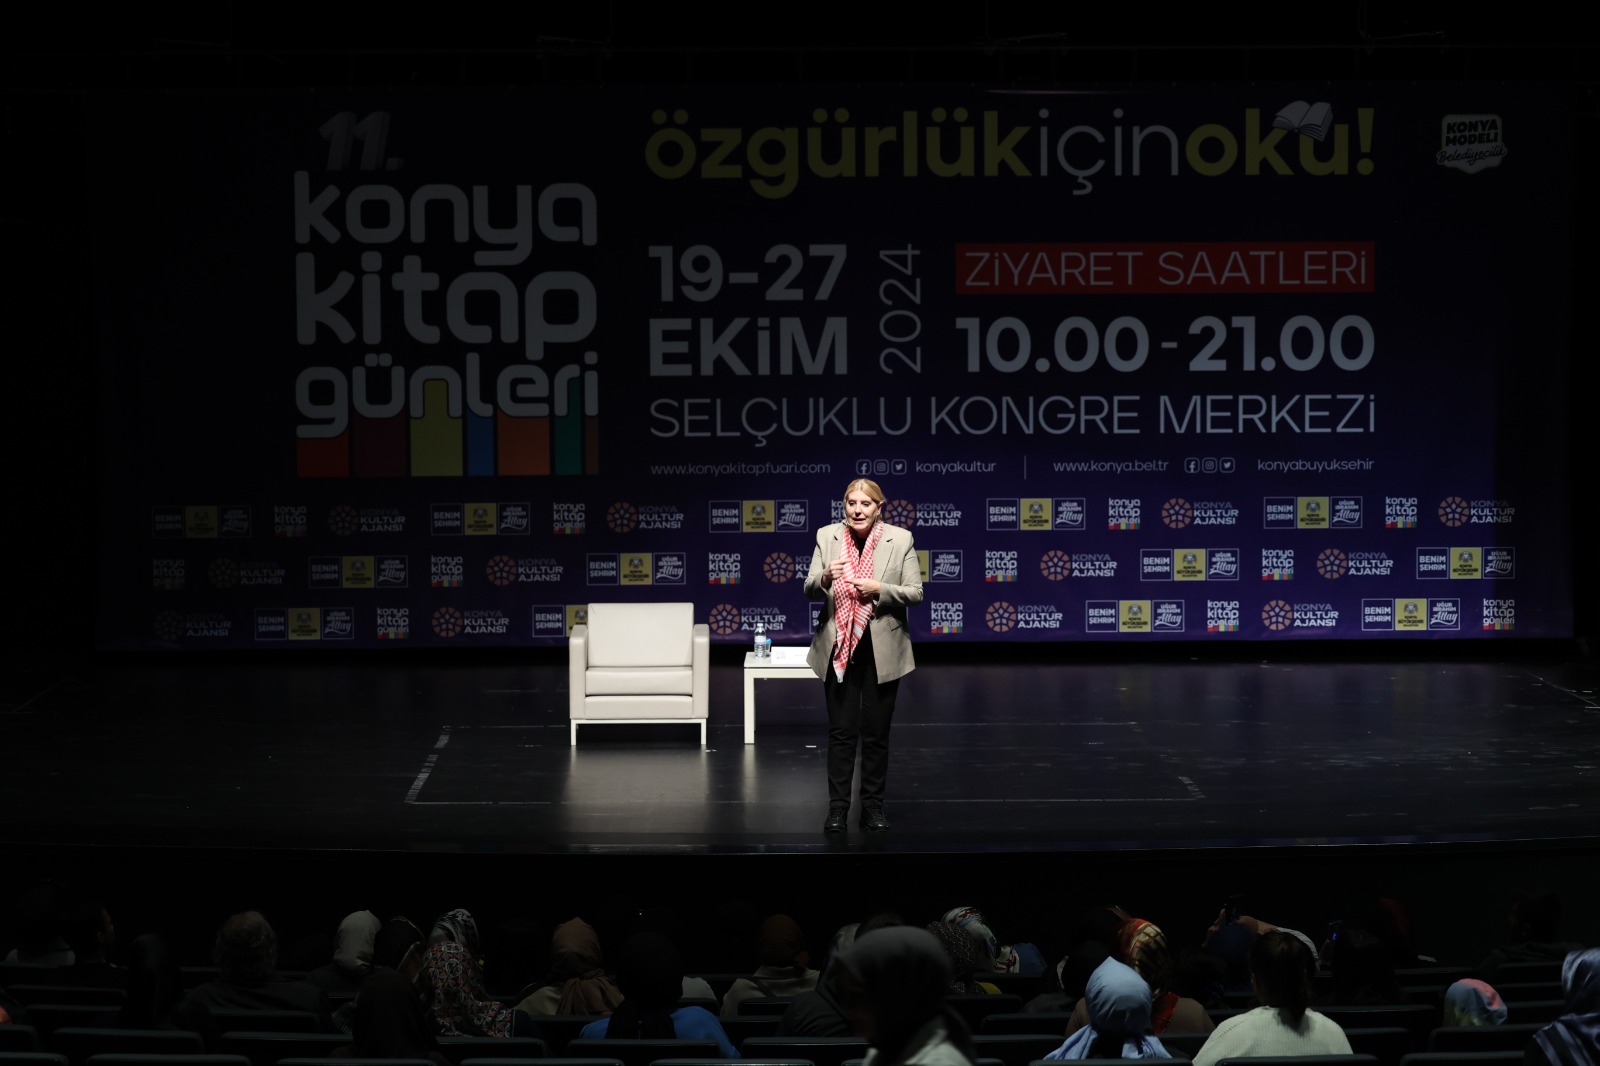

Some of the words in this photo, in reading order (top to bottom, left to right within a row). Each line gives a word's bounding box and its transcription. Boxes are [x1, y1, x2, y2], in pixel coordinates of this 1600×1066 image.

[1446, 118, 1498, 134] KONYA
[318, 111, 404, 171] 11.
[1438, 145, 1506, 165] Belediyecilik
[294, 170, 598, 266] konya
[295, 251, 598, 361] kitap
[879, 243, 921, 375] 2024
[295, 351, 599, 438] günleri
[649, 397, 912, 448] SELÇUKLU
[931, 396, 1141, 435] KONGRE
[650, 460, 831, 477] www.konyakitapfuari.com
[915, 460, 996, 475] konyakultur
[1053, 460, 1169, 474] www.konya.bel.tr
[1257, 458, 1375, 473] konyabuyuksehir
[1108, 498, 1140, 509] konya
[1386, 496, 1418, 507] konya
[554, 502, 586, 513] konya
[1108, 507, 1140, 518] kitap
[1386, 505, 1417, 516] kitap
[554, 511, 585, 522] kitap
[916, 518, 958, 526] AJANSI
[708, 552, 740, 563] konya
[986, 550, 1018, 561] konya
[1262, 548, 1294, 559] konya
[708, 561, 740, 572] kitap
[986, 559, 1017, 570] kitap
[1262, 557, 1294, 568] kitap
[518, 574, 560, 582] AJANSI
[930, 602, 962, 613] konya
[1208, 600, 1240, 611] konya
[1482, 598, 1514, 609] konya
[930, 611, 962, 622] kitap
[1208, 609, 1239, 620] kitap
[1482, 607, 1514, 618] kitap
[1017, 620, 1059, 628] AJANSI
